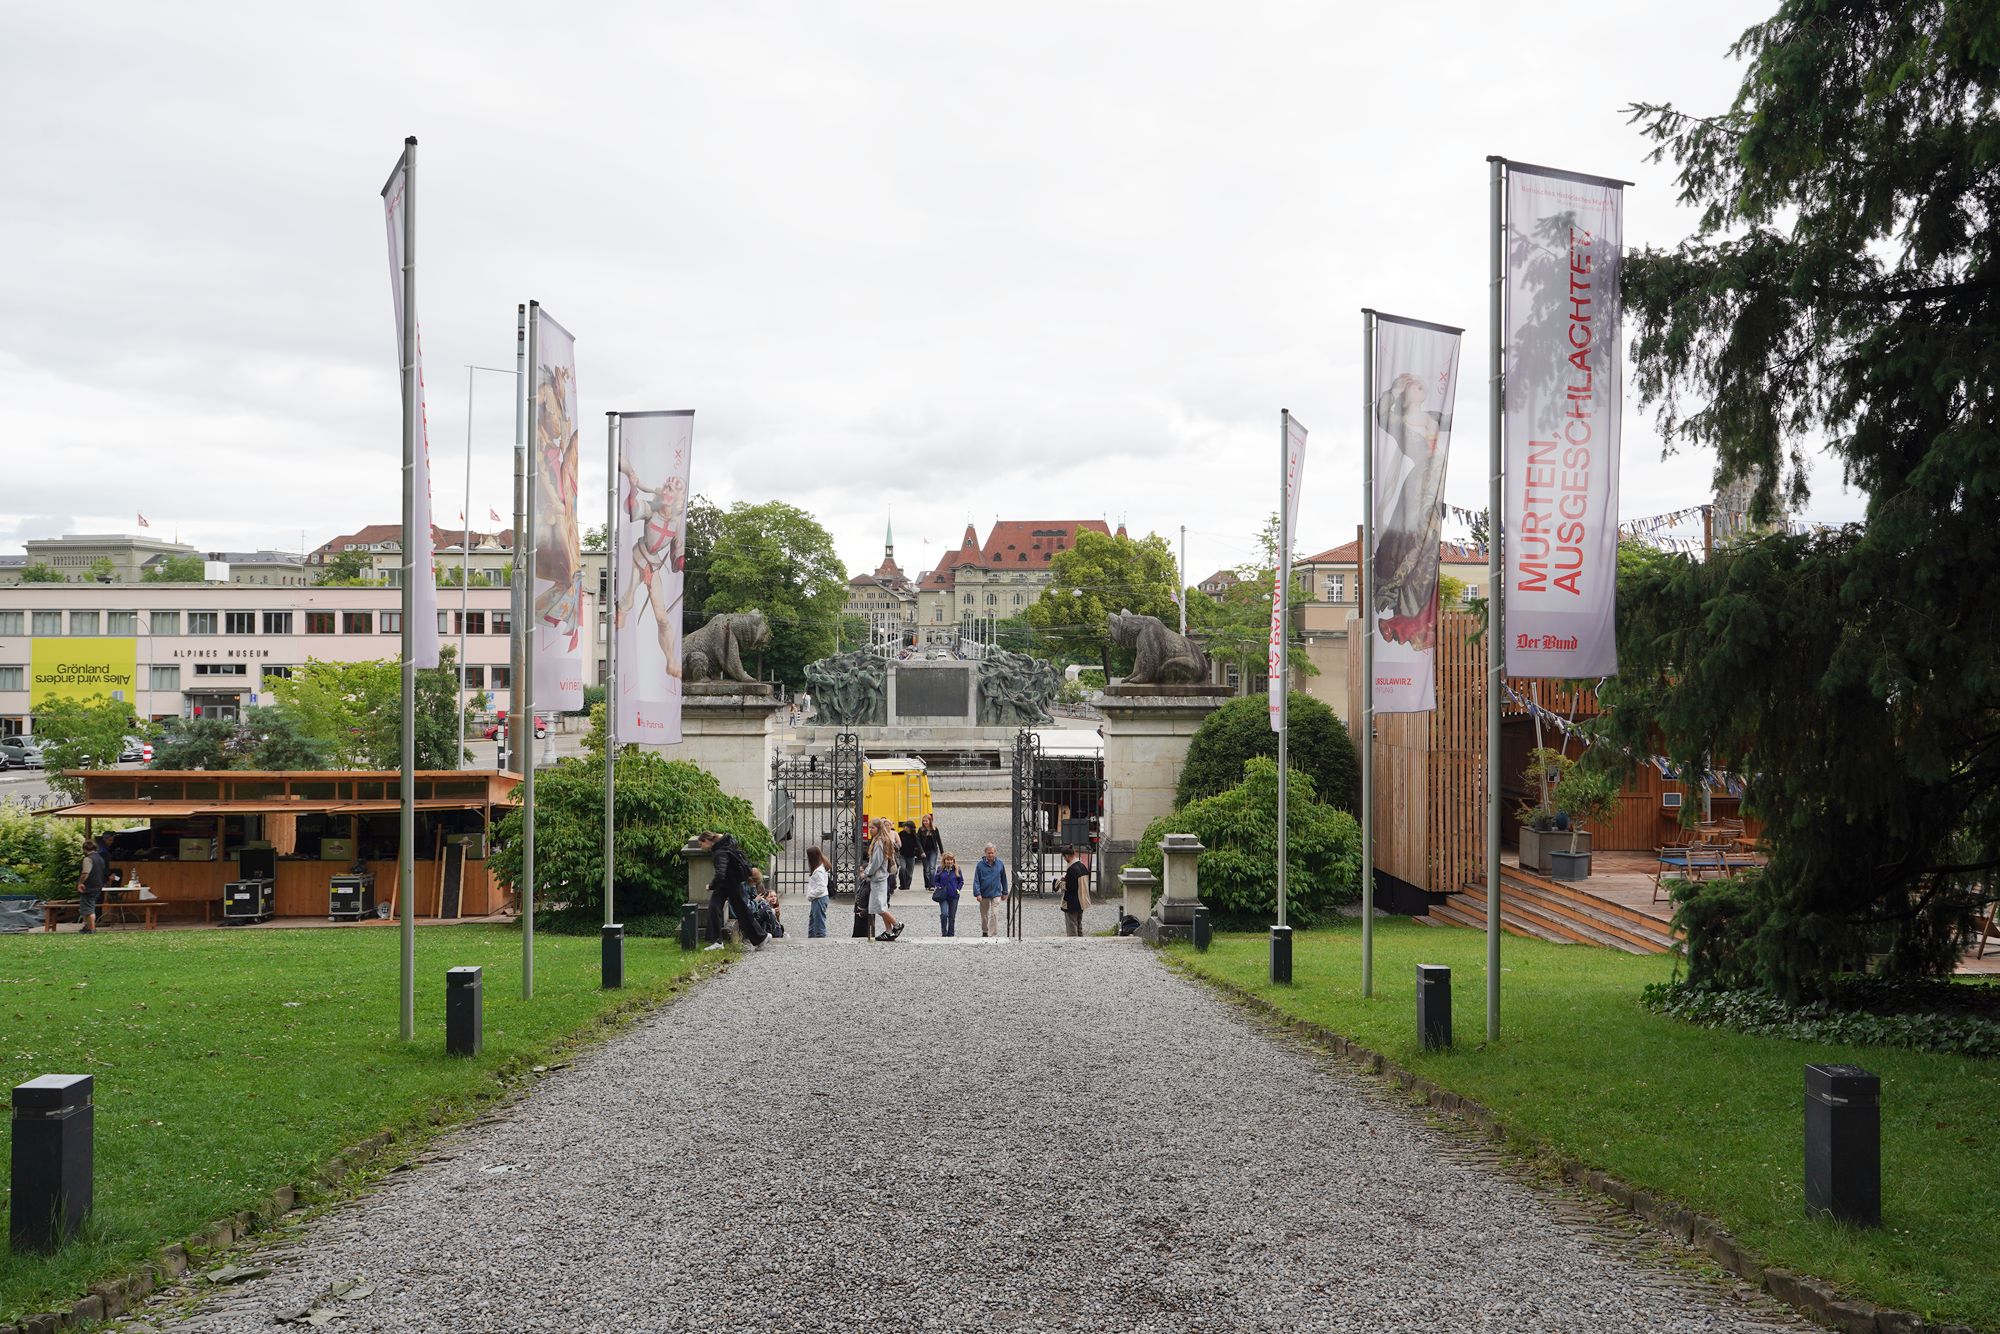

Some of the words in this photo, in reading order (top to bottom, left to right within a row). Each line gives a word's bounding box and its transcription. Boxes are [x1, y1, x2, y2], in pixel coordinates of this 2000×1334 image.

[1517, 431, 1562, 592] MURTEN,
[1516, 633, 1541, 649] Der
[1542, 634, 1578, 650] Bund
[173, 649, 218, 658] ALPINES
[228, 649, 269, 658] MUSEUM
[56, 663, 110, 675] Grönland
[35, 674, 75, 685] anders
[77, 674, 102, 685] wird
[103, 674, 131, 685] Alles
